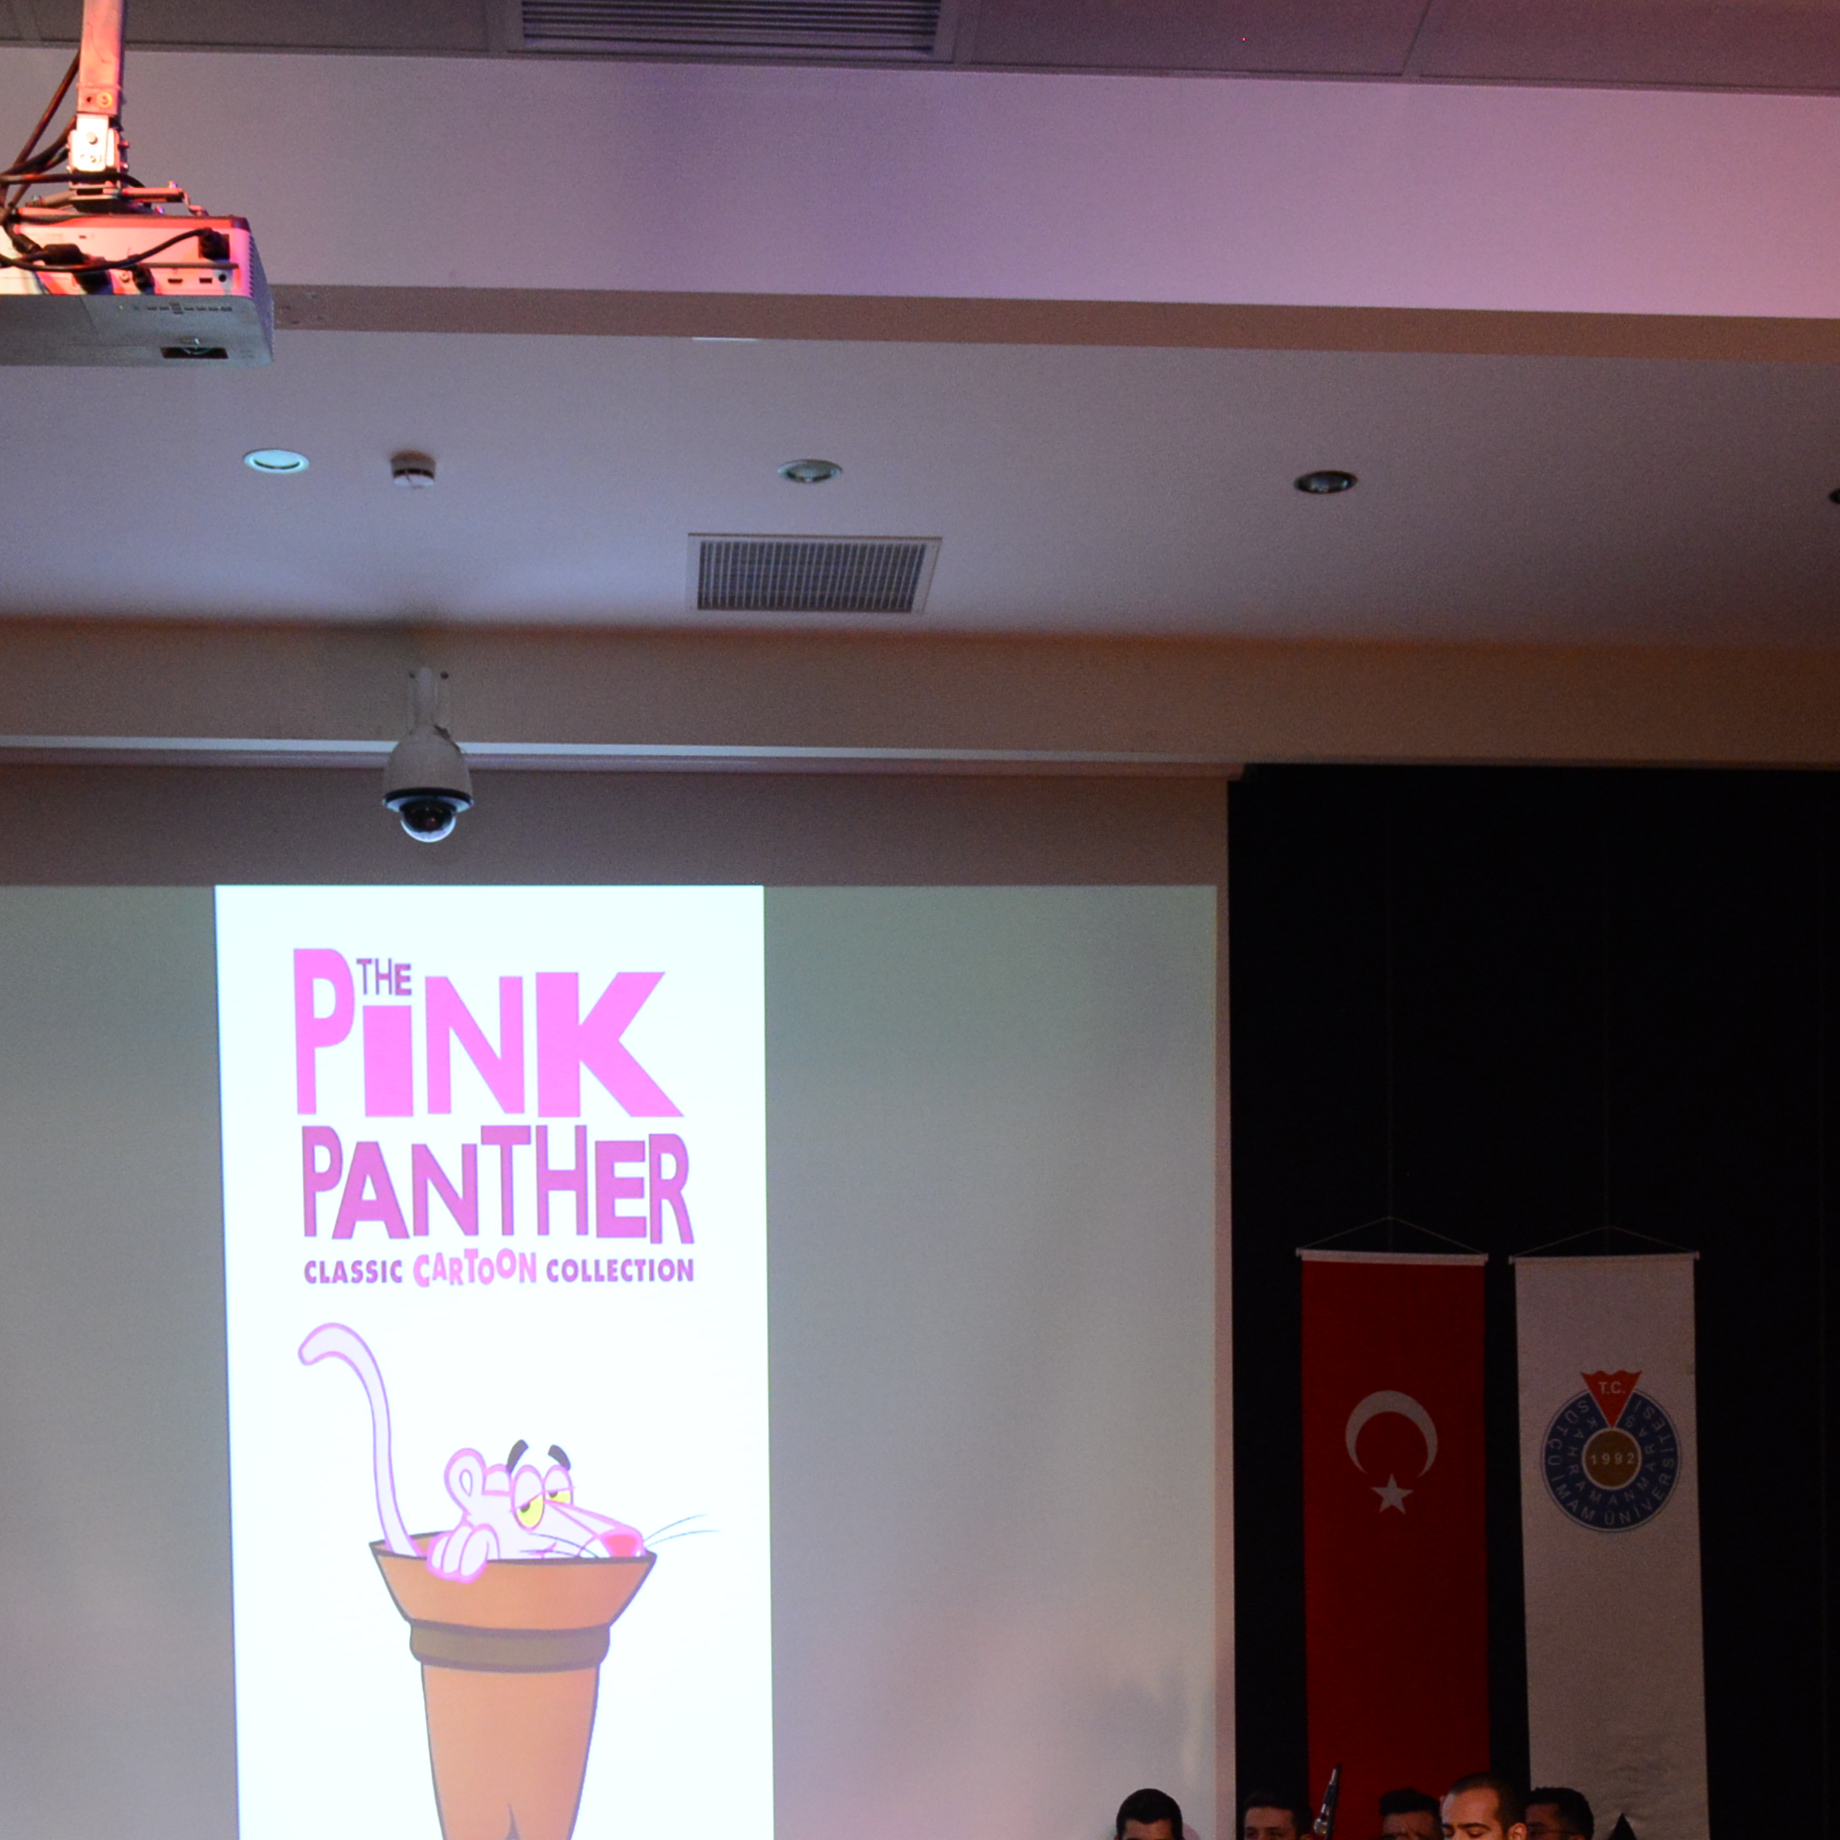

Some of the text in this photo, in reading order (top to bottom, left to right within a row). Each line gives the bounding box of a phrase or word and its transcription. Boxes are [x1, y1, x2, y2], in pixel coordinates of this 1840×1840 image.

[356, 958, 412, 997] THE
[302, 1125, 695, 1245] PANTHER
[304, 1247, 695, 1288] CLASSIC CARTOON COLLECTION
[1598, 1381, 1626, 1395] T.C.
[1590, 1452, 1635, 1465] 1992
